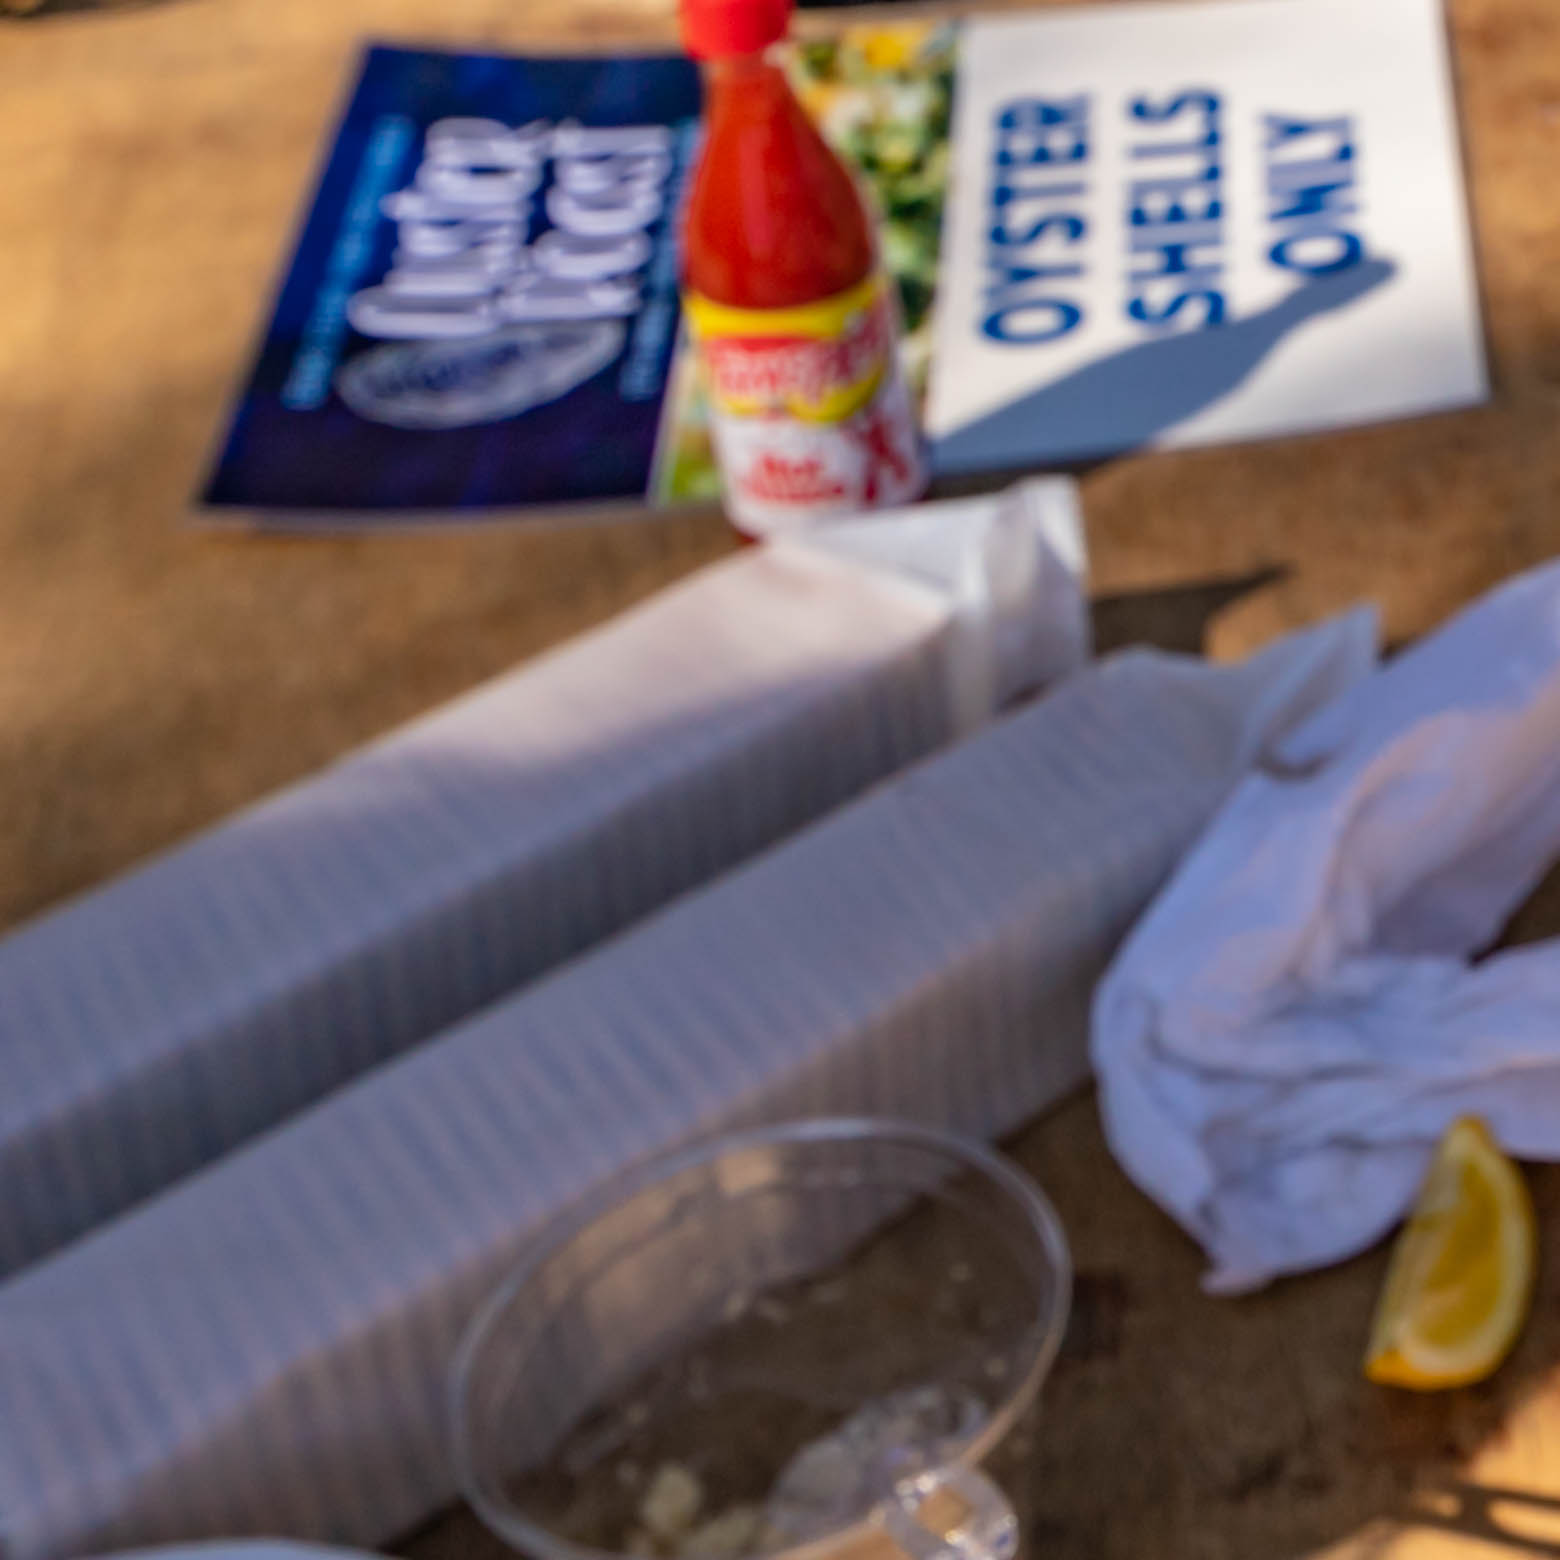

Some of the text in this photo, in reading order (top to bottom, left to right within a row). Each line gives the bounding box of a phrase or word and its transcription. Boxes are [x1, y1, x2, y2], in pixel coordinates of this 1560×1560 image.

[980, 93, 1091, 343] OYSTER
[1127, 87, 1226, 329] SHELLS
[1262, 111, 1363, 276] ONLY
